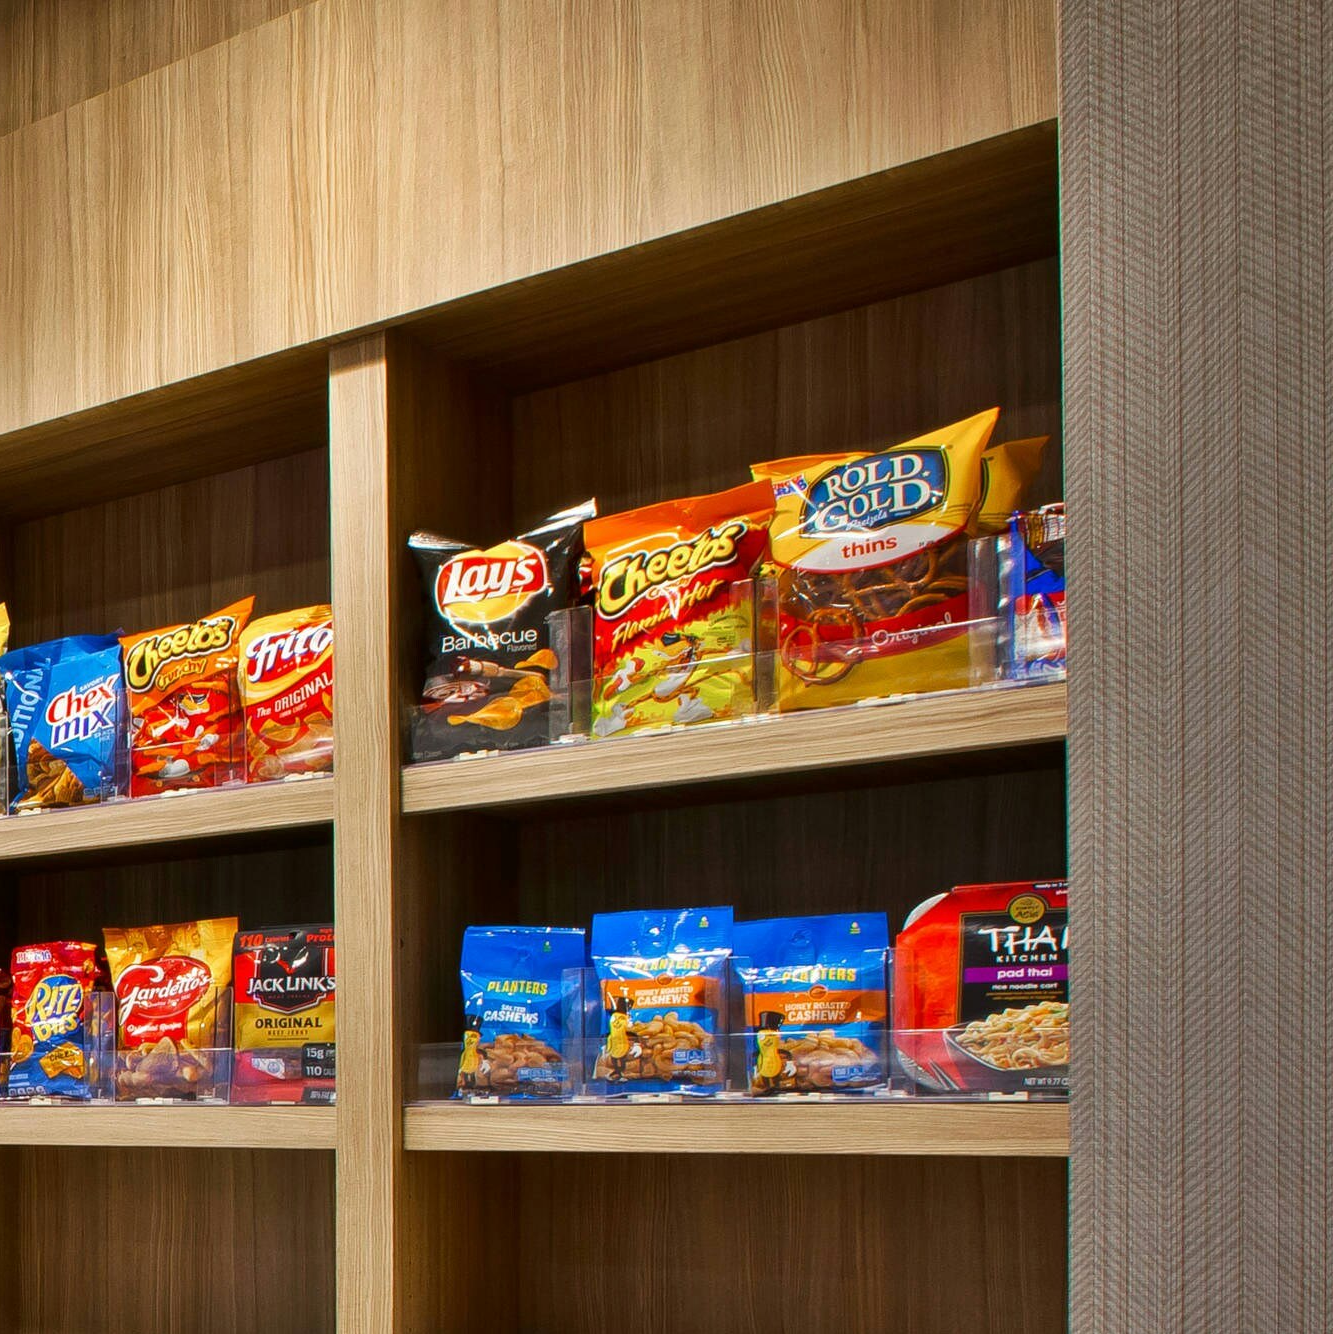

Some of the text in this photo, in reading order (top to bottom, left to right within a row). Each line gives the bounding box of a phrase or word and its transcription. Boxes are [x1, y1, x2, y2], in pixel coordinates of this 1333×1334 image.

[824, 454, 929, 500] ROLD
[815, 478, 931, 533] GOLD
[842, 537, 898, 560] thins
[598, 523, 747, 617] Cheetos
[443, 555, 537, 606] Lay's
[680, 579, 725, 607] Hot
[441, 628, 538, 654] Barbecue
[128, 616, 232, 690] Cheetos
[79, 677, 104, 693] SAVORY
[48, 676, 118, 723] Chex
[256, 673, 332, 718] The ORIGINAL
[239, 934, 263, 947] 110
[996, 953, 1058, 963] KITCHEN
[996, 966, 1053, 981] pad thai
[247, 976, 336, 994] JACK LINK'S
[487, 980, 548, 996] PLANTERS
[661, 985, 693, 994] ROASTED
[119, 965, 213, 1025] Gardetto's
[637, 993, 690, 1006] CASHEWS
[27, 983, 81, 1025] RITZ
[785, 1001, 852, 1011] HONEY ROASTED
[255, 1017, 323, 1029] ORIGINAL
[483, 1010, 539, 1025] CASHEWS
[787, 1010, 846, 1022] CASHEWS
[306, 1047, 324, 1059] 15g
[306, 1066, 322, 1076] 110
